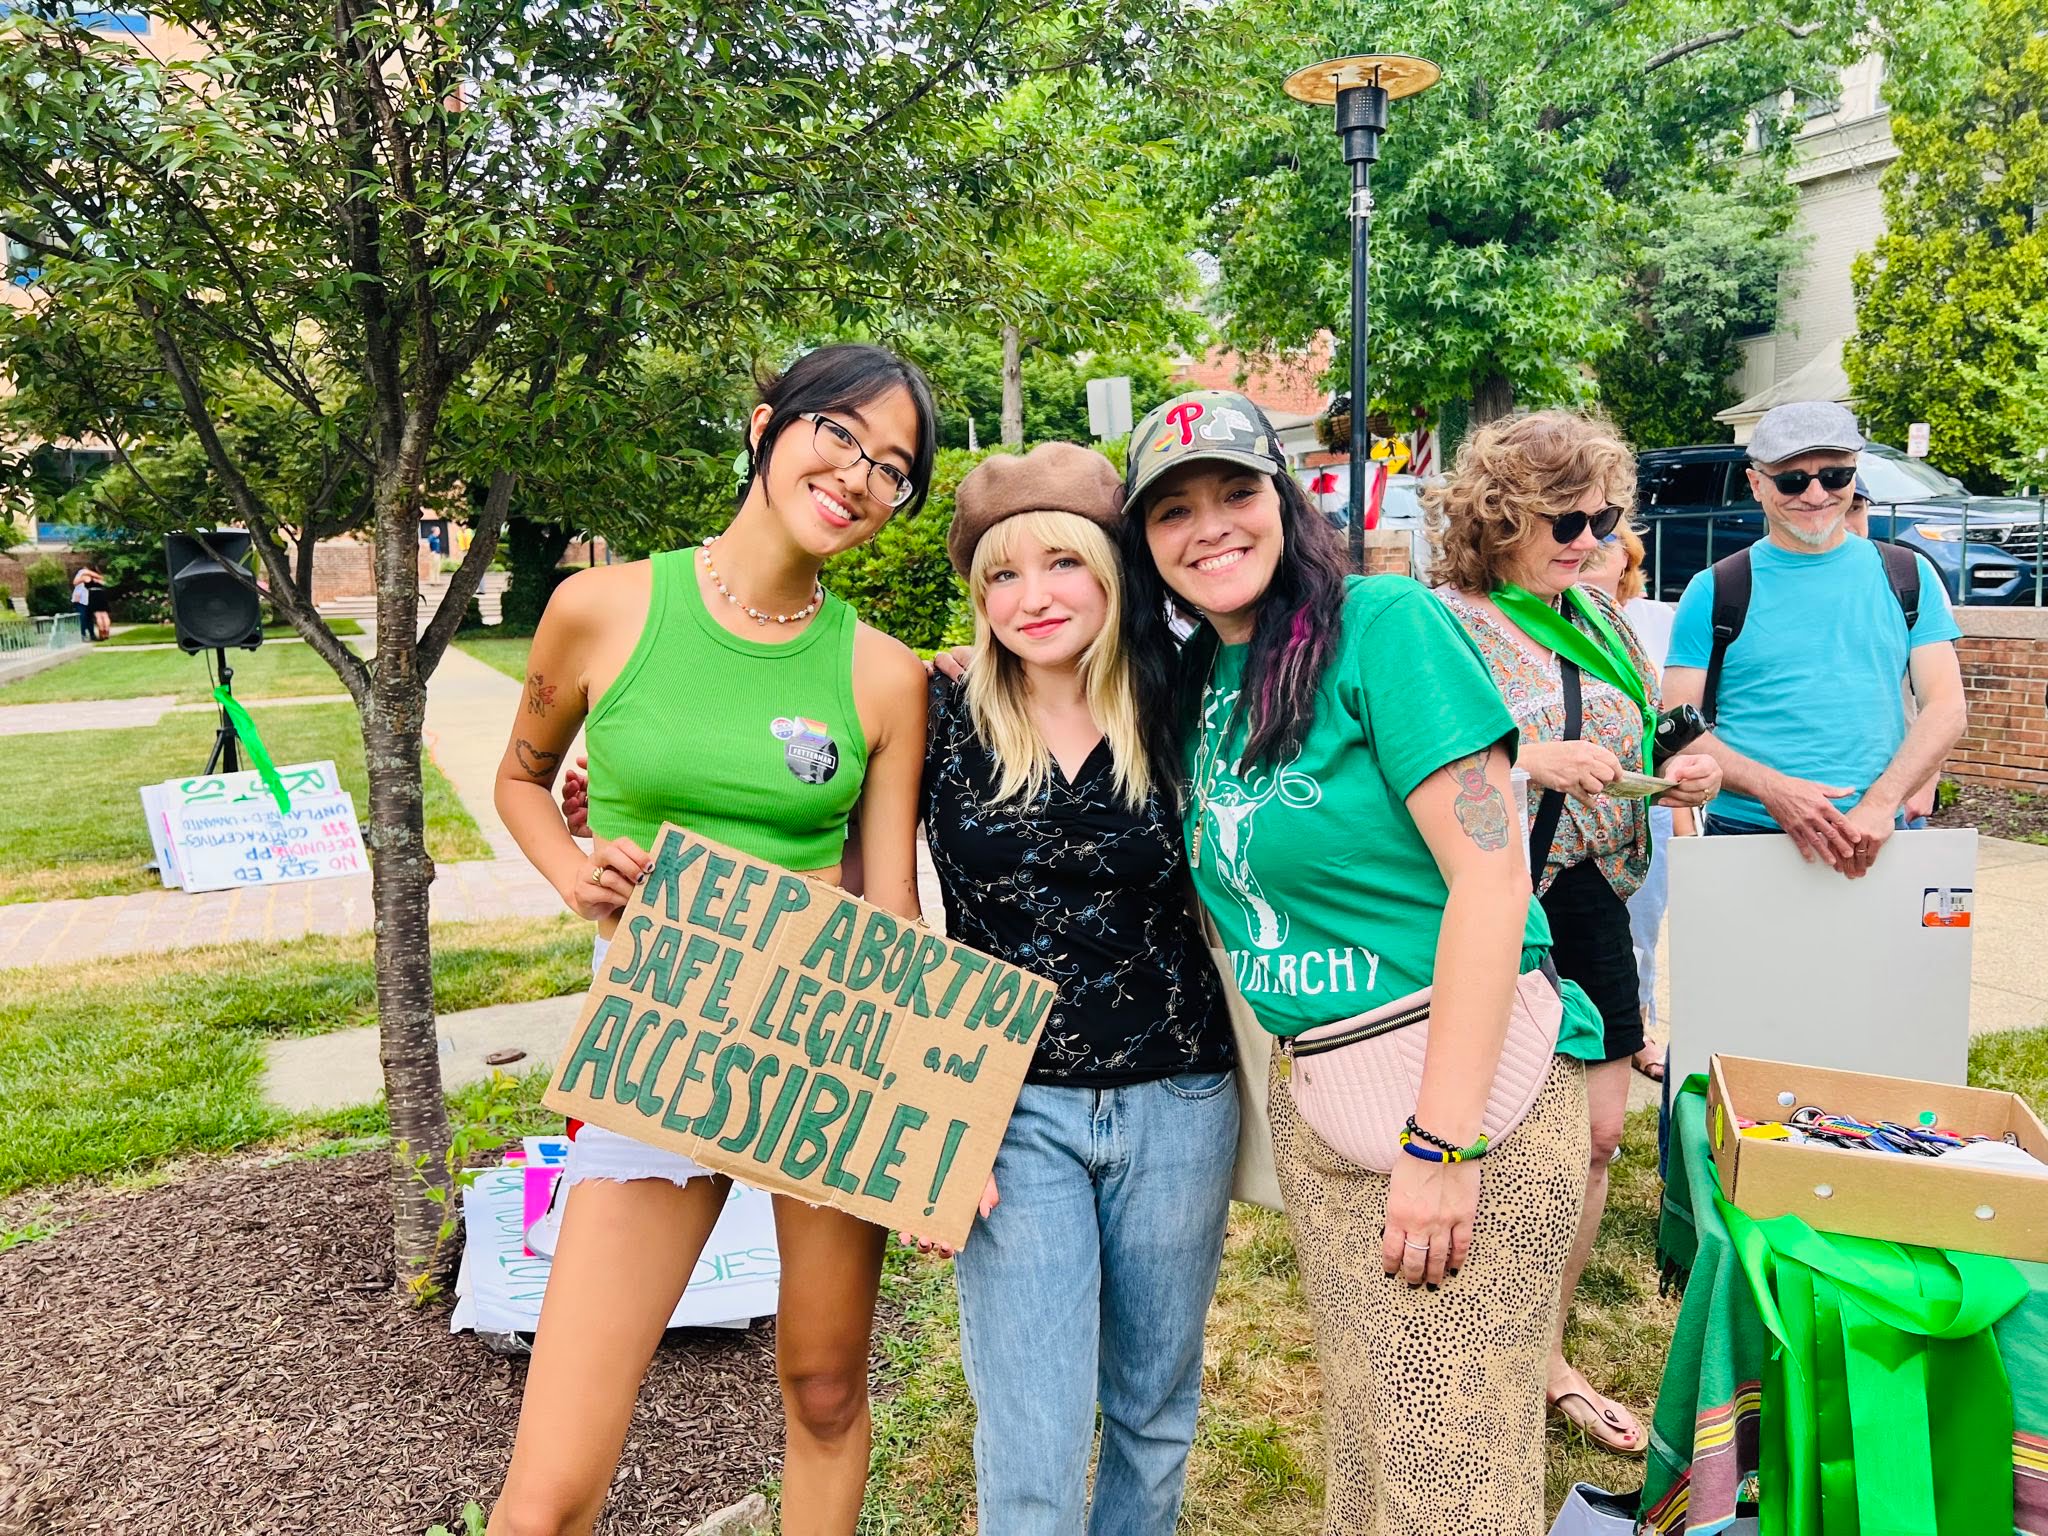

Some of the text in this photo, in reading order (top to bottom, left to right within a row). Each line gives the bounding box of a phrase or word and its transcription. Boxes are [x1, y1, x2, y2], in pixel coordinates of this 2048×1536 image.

[1165, 401, 1205, 446] P
[793, 747, 832, 765] FETTERMAN
[234, 853, 358, 881] NO SEX ED
[246, 847, 272, 861] PP
[641, 829, 1058, 1046] KEEP ABORTION
[608, 915, 989, 1089] SAFE, LEGAL, and
